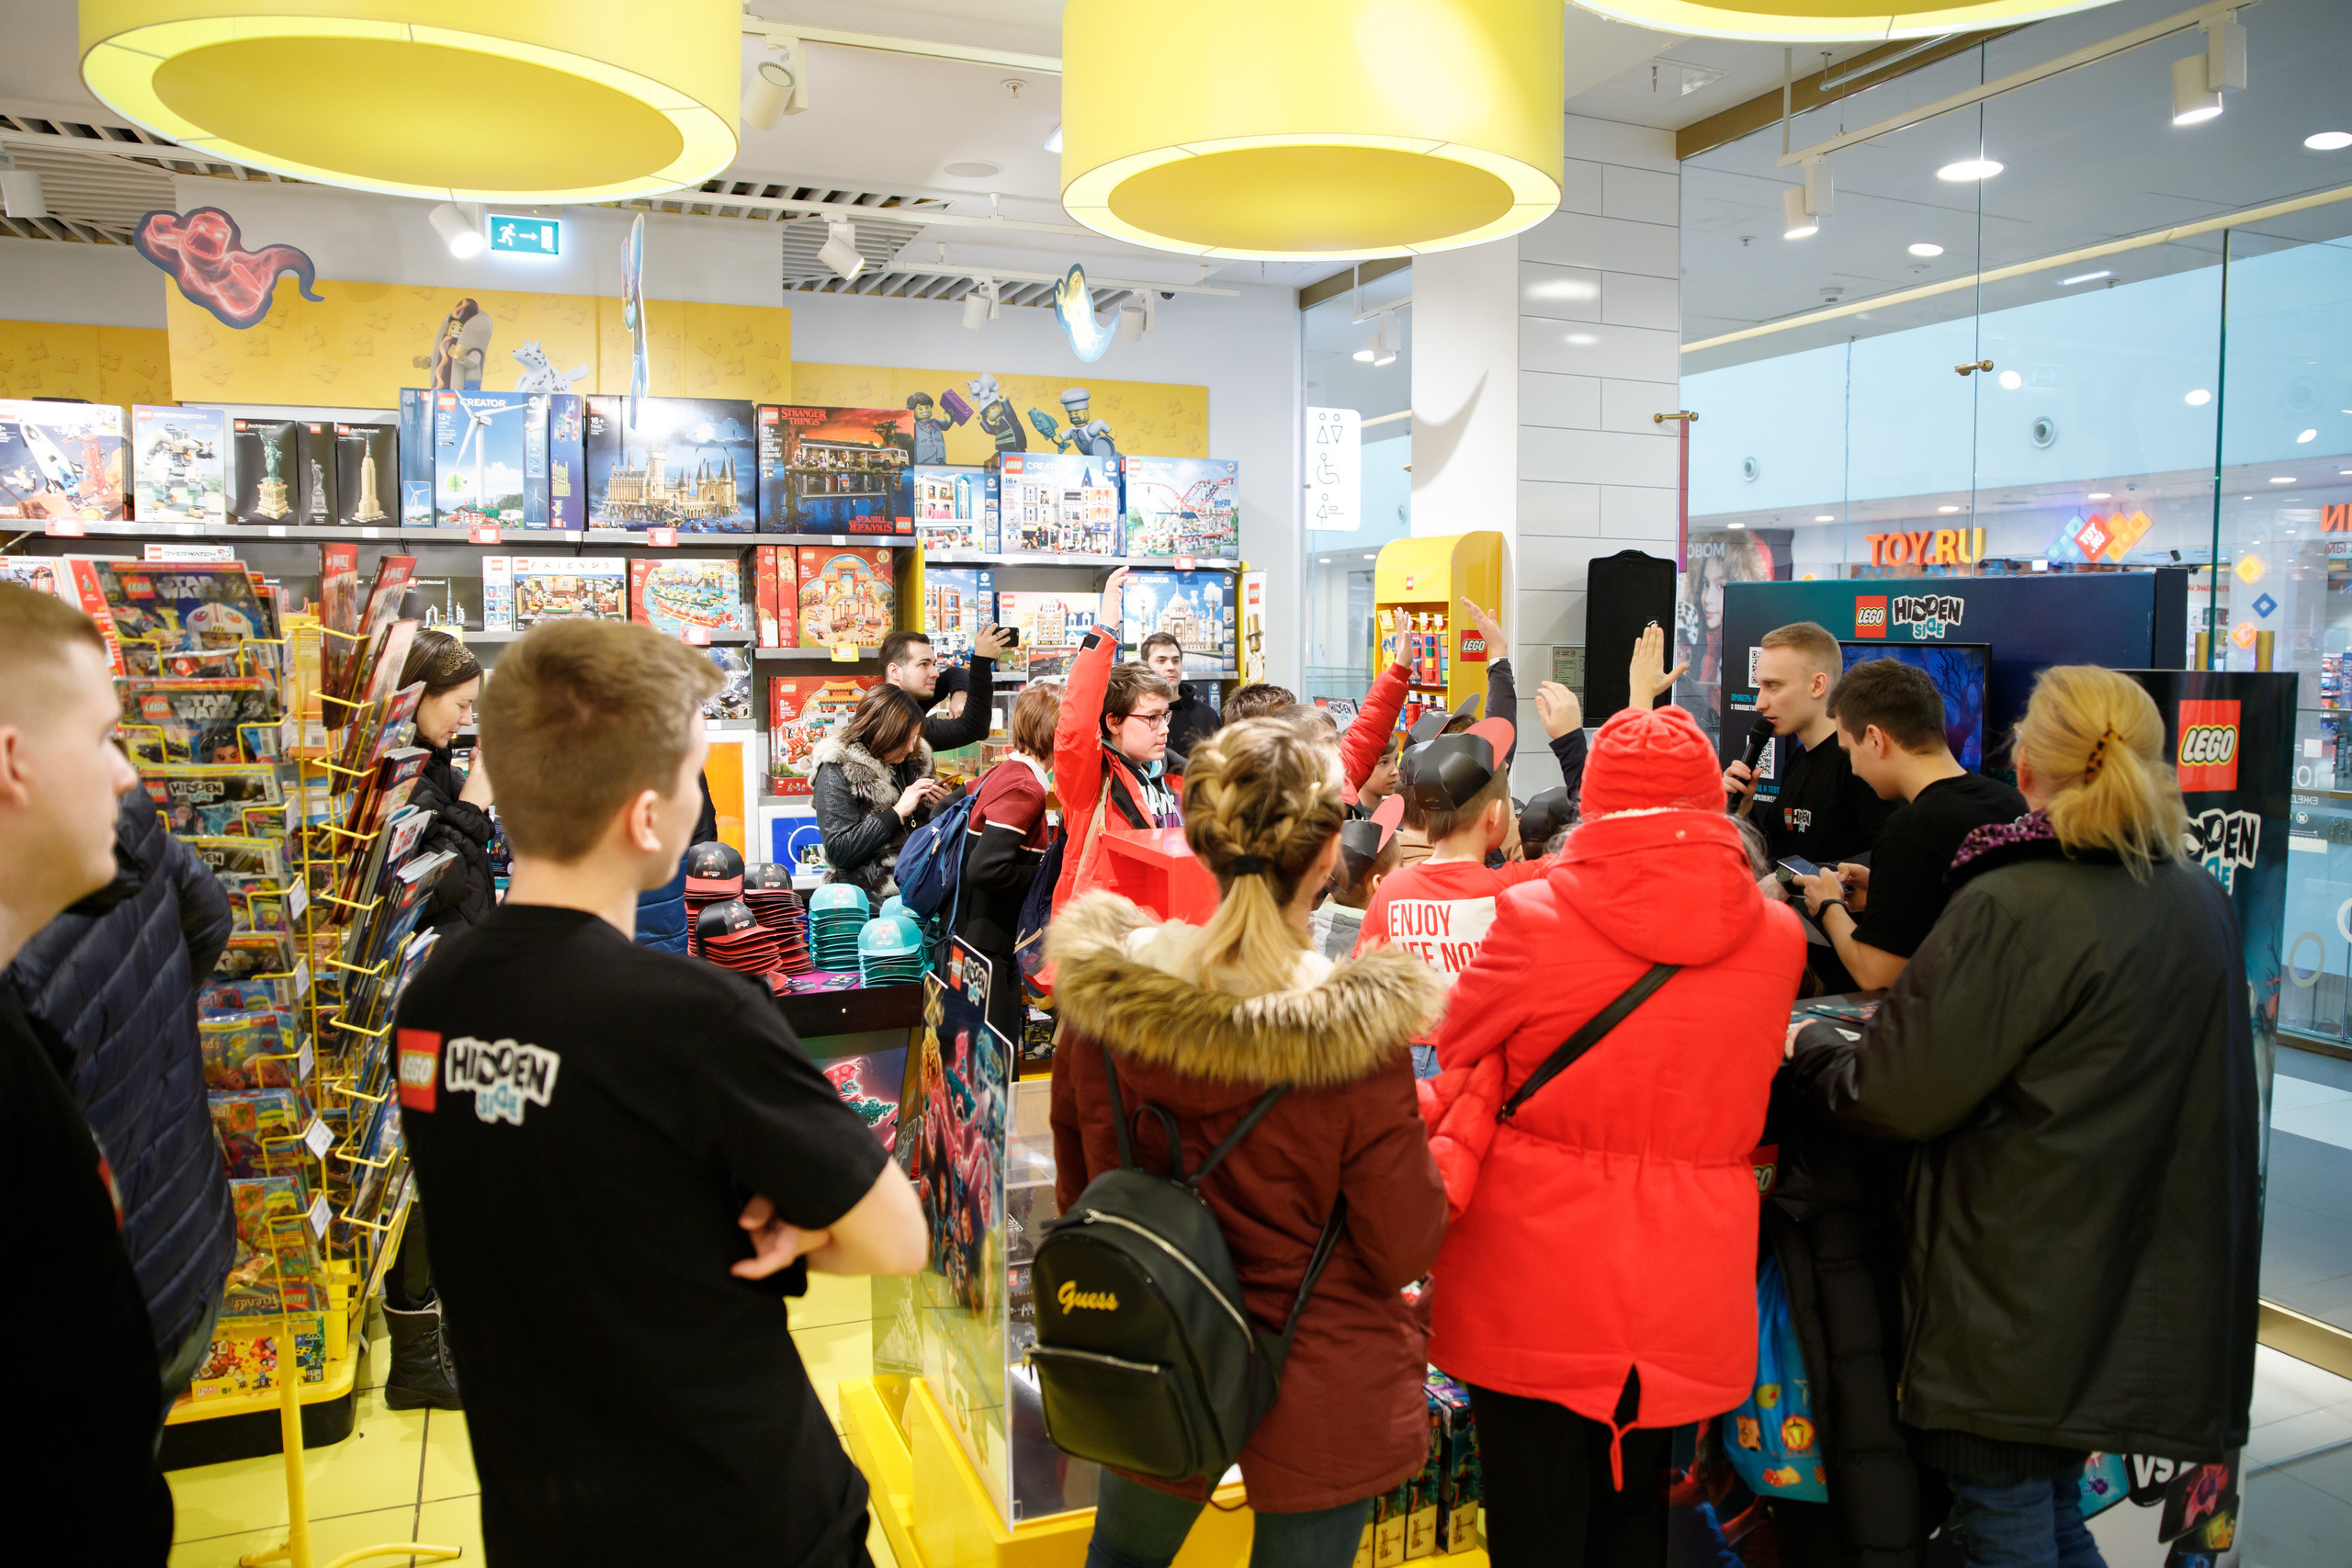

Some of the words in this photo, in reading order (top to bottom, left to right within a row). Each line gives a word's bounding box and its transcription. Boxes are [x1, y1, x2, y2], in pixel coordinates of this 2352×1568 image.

[460, 398, 506, 407] CREATOR
[591, 416, 605, 424] 16+
[762, 412, 778, 420] LEGO
[781, 407, 827, 421] STRANGER
[788, 418, 820, 426] THINGS
[762, 425, 775, 434] 16+
[1006, 461, 1023, 469] LEGO
[855, 515, 886, 524] THINGS
[848, 521, 893, 533] STRANGER
[2078, 522, 2098, 546] TOY
[1865, 527, 1986, 567] TOY.RU
[127, 581, 152, 592] LEGO
[1857, 607, 1885, 626] LEGO
[1893, 594, 1964, 626] HIDDEN
[1913, 617, 1946, 639] SIDE
[1462, 638, 1487, 652] LEGO
[781, 683, 797, 693] LEGO
[1731, 693, 1752, 703] ПРОВЕРЬ
[144, 701, 168, 713] LEGO
[2178, 724, 2238, 767] LEGO
[169, 782, 224, 796] HIDDEN
[1768, 785, 1781, 795] ТЕСТ
[1390, 904, 1452, 938] ENJOY
[399, 1051, 437, 1089] LEGO
[446, 1037, 560, 1107] HIDDEN
[475, 1085, 525, 1126] SIDE
[232, 1290, 281, 1312] Friends
[285, 1295, 307, 1303] LEGO
[1057, 1280, 1119, 1315] Guess
